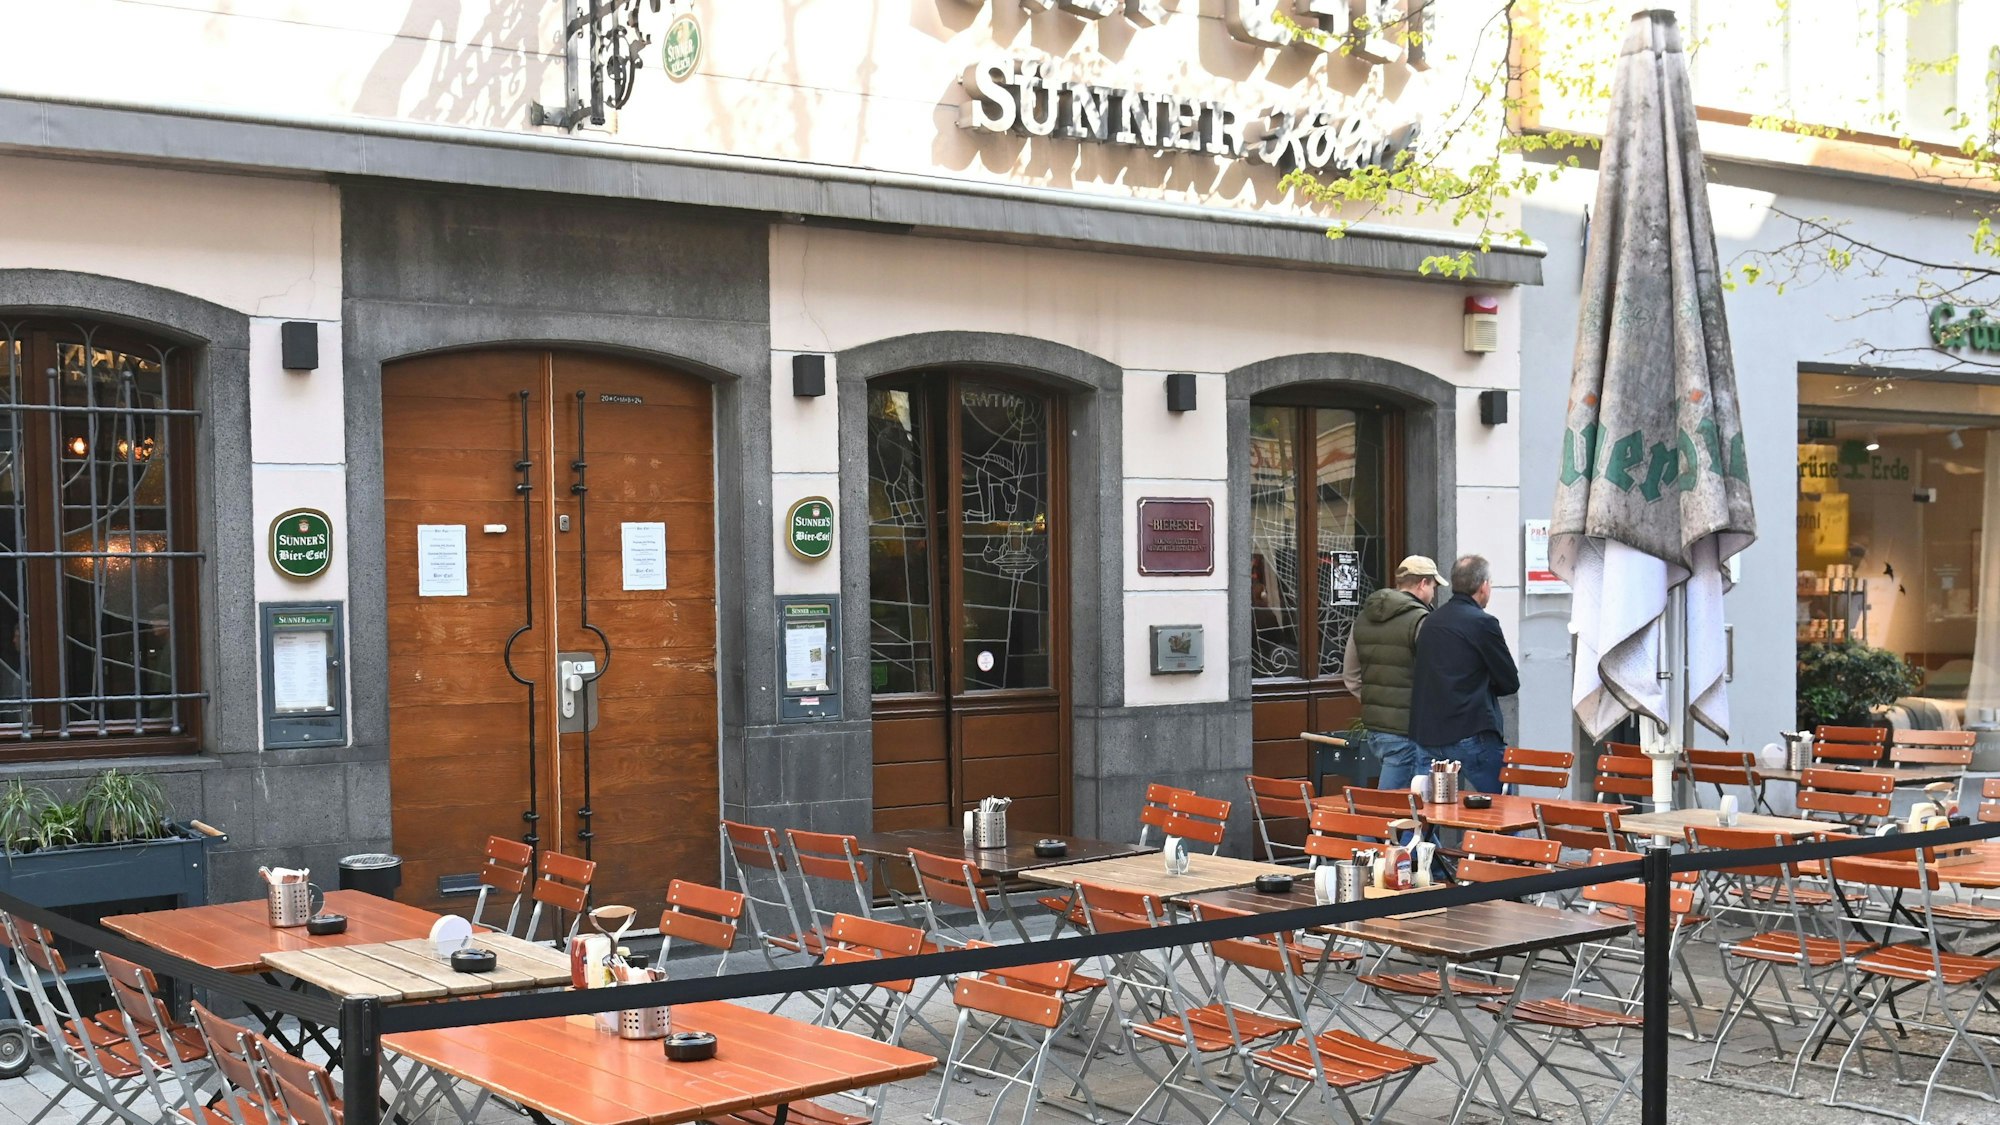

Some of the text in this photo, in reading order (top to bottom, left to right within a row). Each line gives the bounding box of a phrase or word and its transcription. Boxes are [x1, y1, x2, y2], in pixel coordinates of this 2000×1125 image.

[972, 57, 1248, 158] SÜNNER
[1798, 455, 1909, 480] rüne Erde
[279, 549, 327, 561] Bier-Esel
